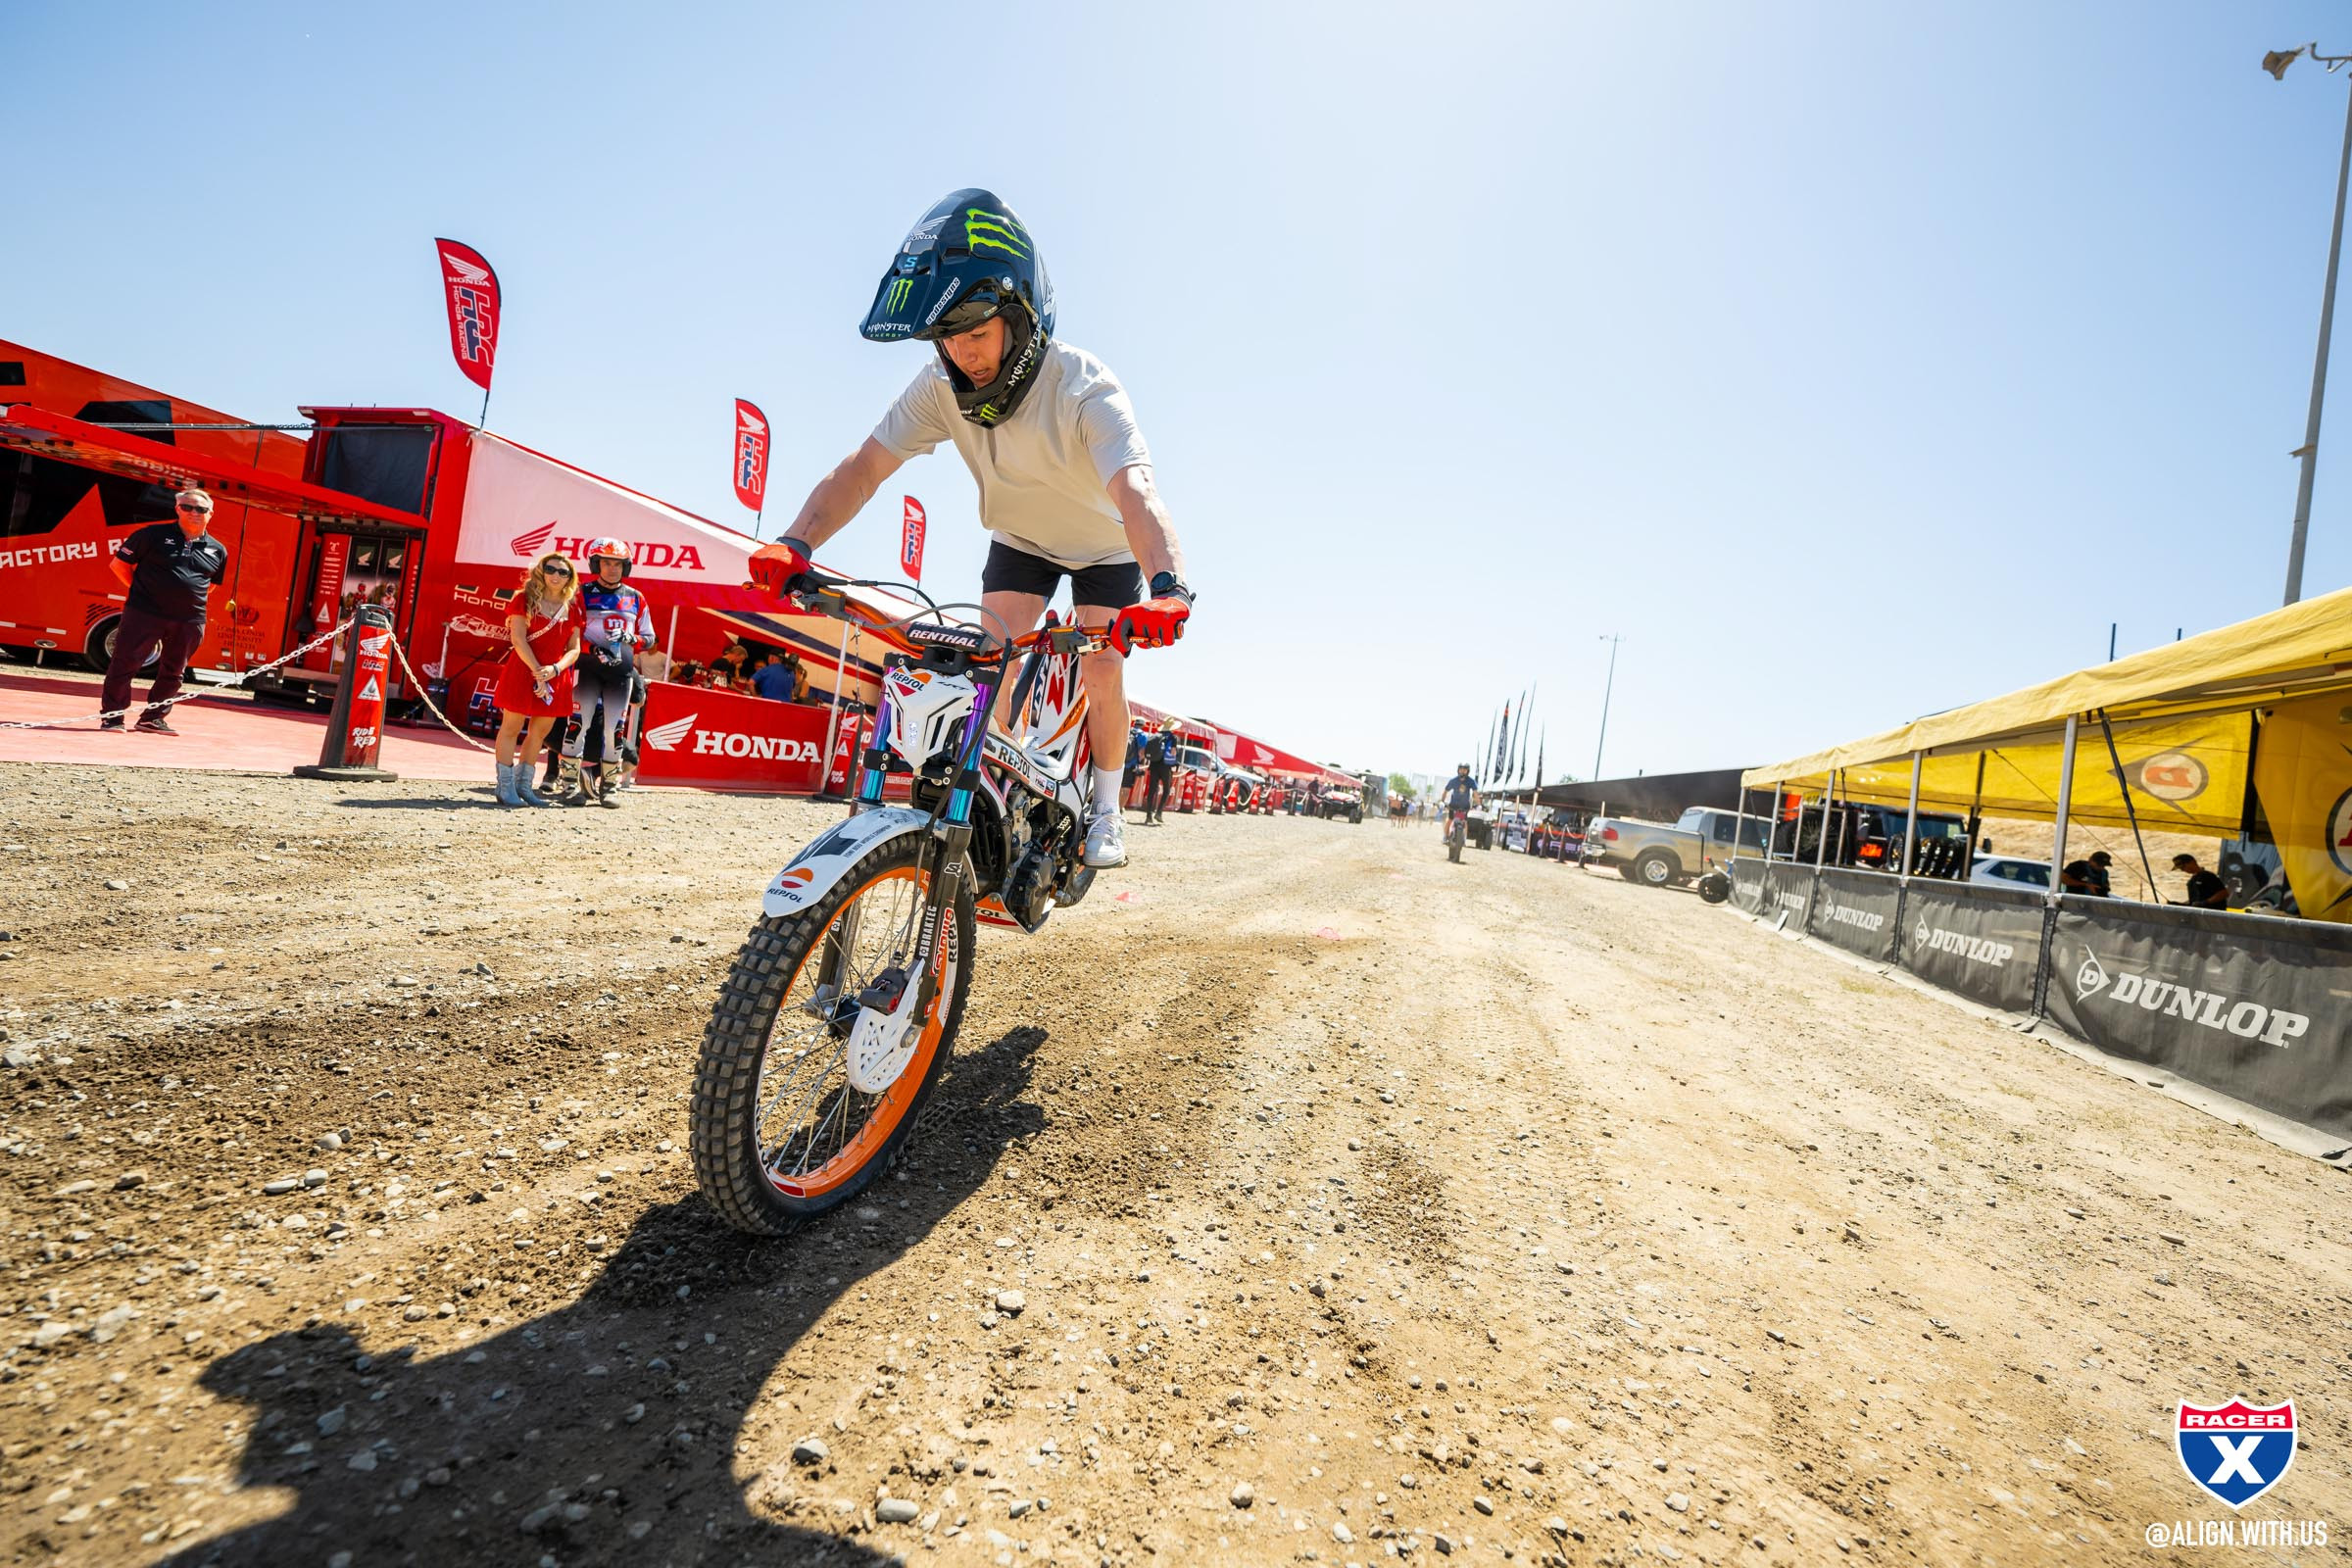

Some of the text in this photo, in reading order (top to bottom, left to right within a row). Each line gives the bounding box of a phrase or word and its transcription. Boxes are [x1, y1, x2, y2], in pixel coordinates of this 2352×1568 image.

[447, 275, 492, 287] HONDA
[453, 285, 468, 360] Honda RACING
[866, 321, 912, 332] MONSTER
[1007, 322, 1043, 386] MONSTER
[554, 536, 706, 570] HNDA
[454, 591, 507, 611] Hond
[908, 629, 978, 648] RENTHAL
[360, 649, 389, 660] HONDA
[891, 671, 925, 692] REPSOL
[352, 726, 375, 738] RIDE
[353, 736, 376, 749] RED
[693, 729, 821, 763] HONDA
[766, 887, 804, 904] REPSOL
[921, 905, 938, 948] BRAKTEC
[1834, 905, 1884, 932] DUNLOP
[1928, 927, 2014, 967] DUNLOP
[2109, 971, 2310, 1048] DUNLOP
